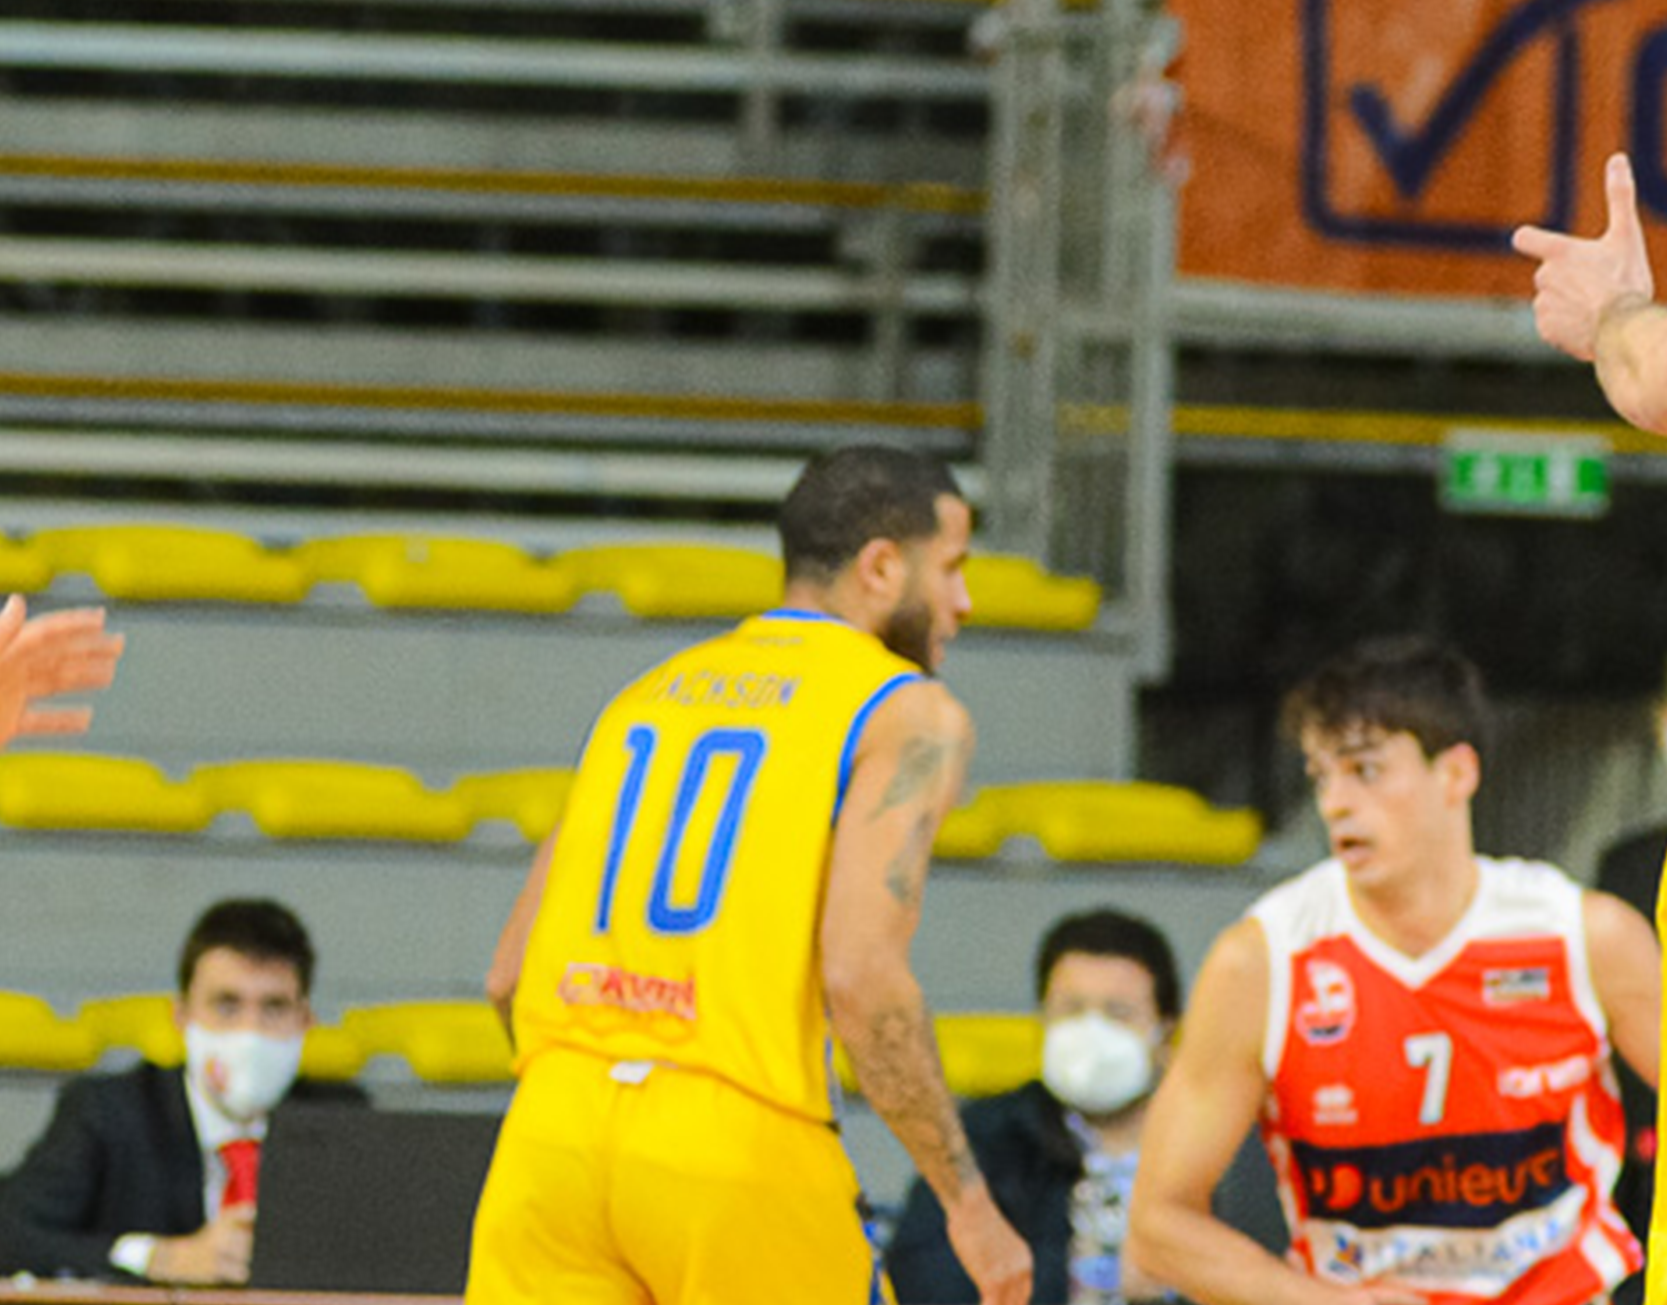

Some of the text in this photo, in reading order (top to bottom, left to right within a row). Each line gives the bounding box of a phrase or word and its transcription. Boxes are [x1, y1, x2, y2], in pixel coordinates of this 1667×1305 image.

[646, 670, 803, 708] JACKSON
[596, 724, 768, 935] 10
[1405, 1031, 1453, 1126] 7
